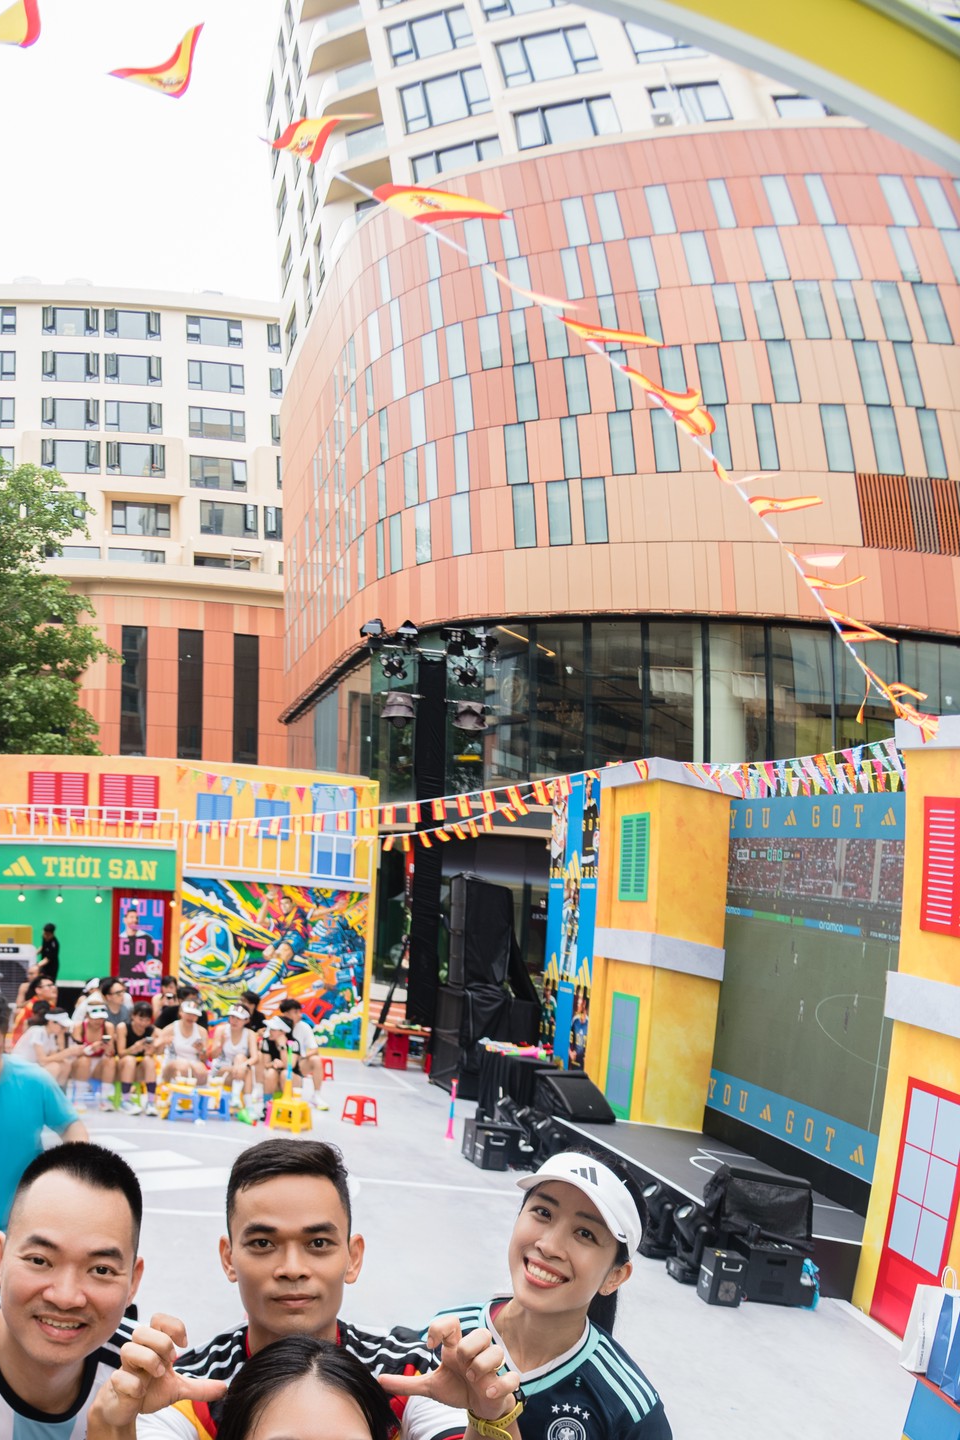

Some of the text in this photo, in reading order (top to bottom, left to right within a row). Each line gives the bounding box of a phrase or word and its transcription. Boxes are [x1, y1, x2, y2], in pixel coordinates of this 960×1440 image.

[730, 804, 864, 829] YOU GOT
[42, 855, 101, 879] THỜI
[108, 858, 158, 881] SAN
[120, 898, 165, 917] YOU
[818, 920, 844, 933] aramco
[119, 938, 162, 957] GOT
[709, 1078, 836, 1152] YOU GOT
